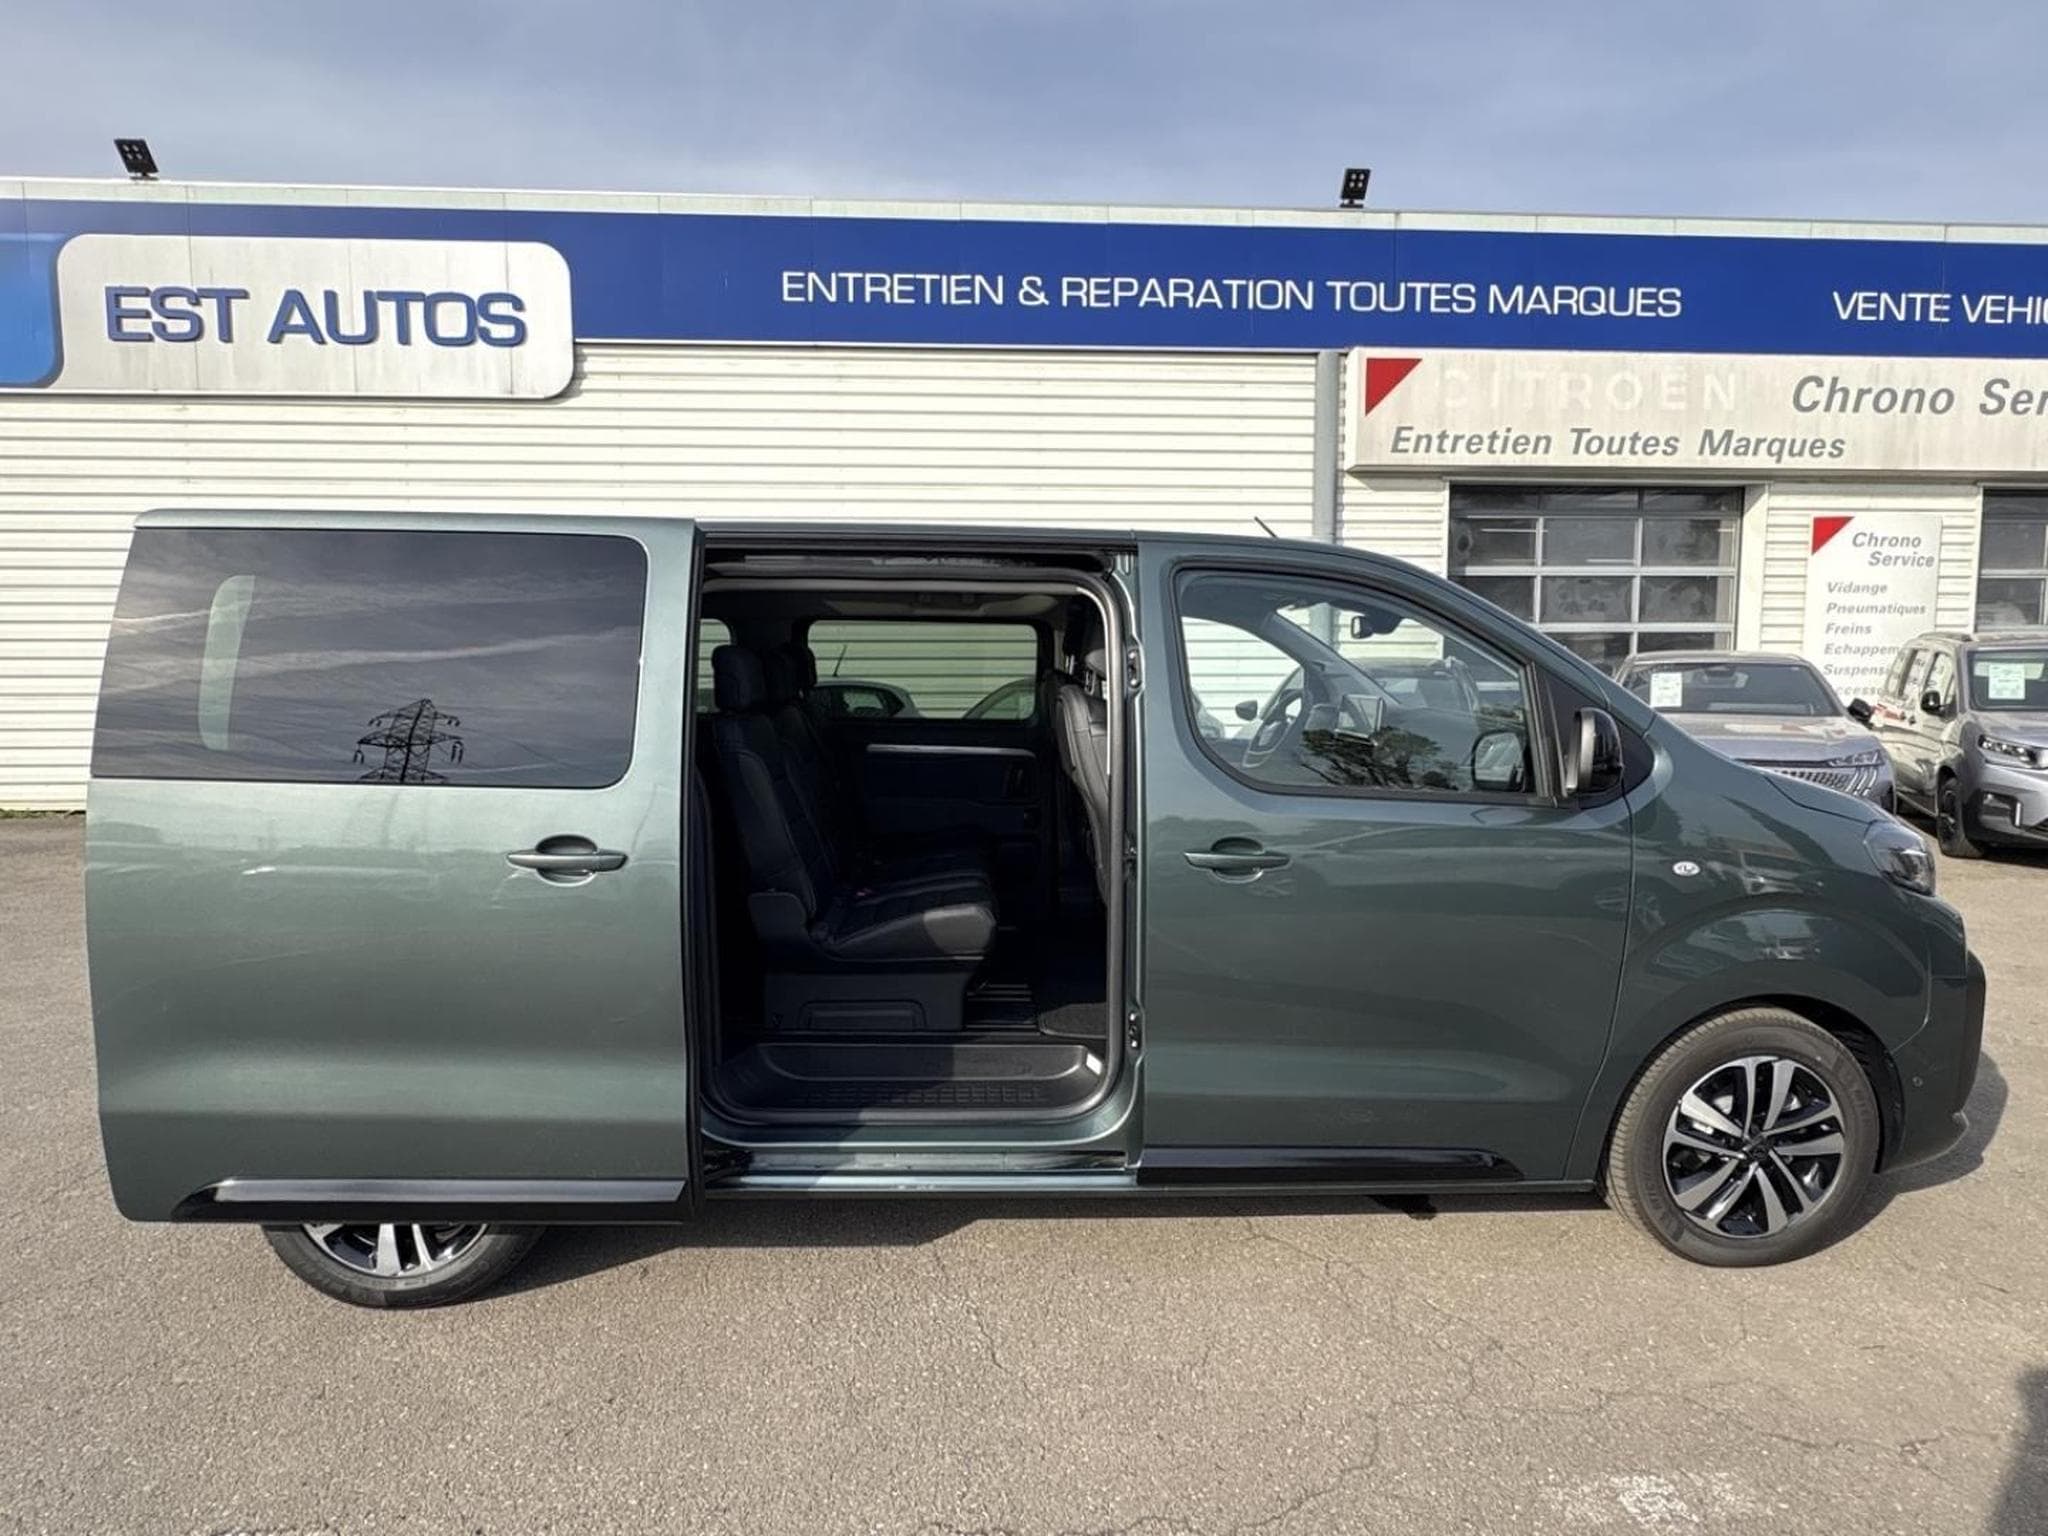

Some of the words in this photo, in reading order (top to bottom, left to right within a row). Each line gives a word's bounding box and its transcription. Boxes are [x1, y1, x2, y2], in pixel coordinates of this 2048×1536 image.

[781, 271, 1004, 305] ENTRETIEN
[1018, 277, 1049, 306] &
[1061, 277, 1314, 311] REPARATION
[1327, 281, 1476, 313] TOUTES
[1489, 284, 1682, 318] MARQUES
[1832, 290, 1951, 323] VENTE
[104, 286, 249, 343] EST
[267, 289, 526, 347] AUTOS
[1792, 375, 1955, 415] Chrono
[1391, 426, 1553, 455] Entretien
[1570, 427, 1680, 457] Toutes
[1698, 429, 1846, 464] Marques
[1852, 532, 1922, 548] Chrono
[1868, 551, 1935, 568] Service
[1827, 581, 1888, 595] Vidange
[1826, 602, 1926, 617] Pneumatiques
[1825, 622, 1872, 635] Freins
